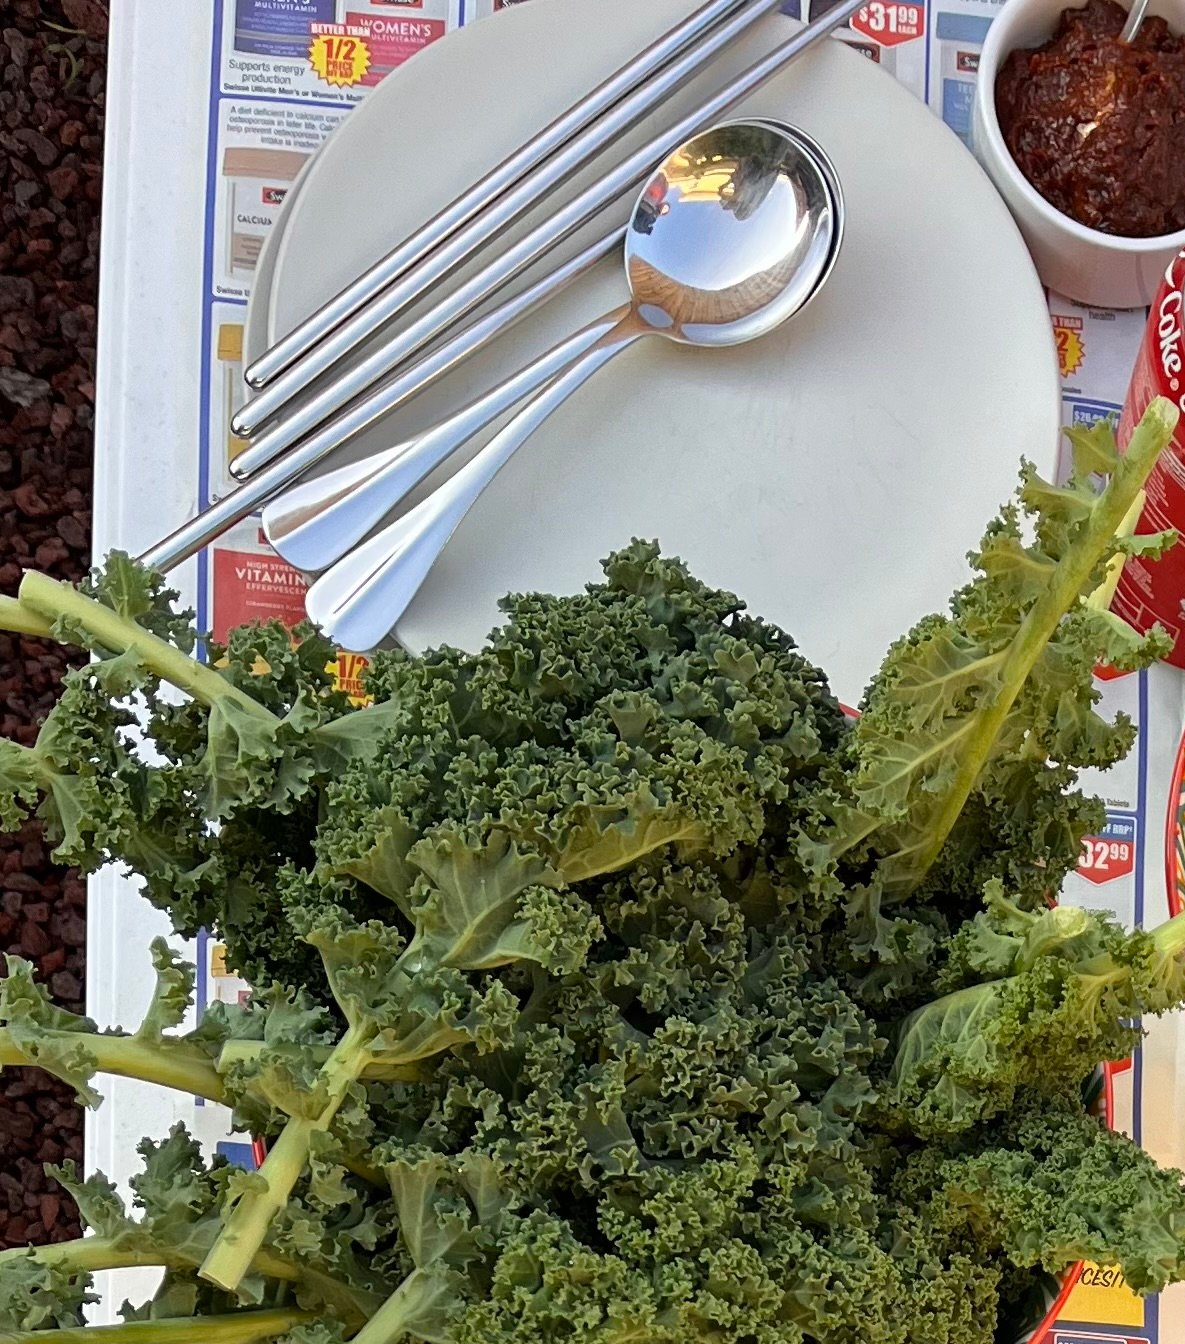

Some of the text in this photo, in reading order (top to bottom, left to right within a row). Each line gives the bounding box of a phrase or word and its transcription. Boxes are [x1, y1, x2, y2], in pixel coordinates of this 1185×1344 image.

[323, 39, 356, 61] 1/2
[228, 59, 304, 76] Supports energy
[241, 74, 292, 85] production
[235, 567, 306, 586] VITAMIN
